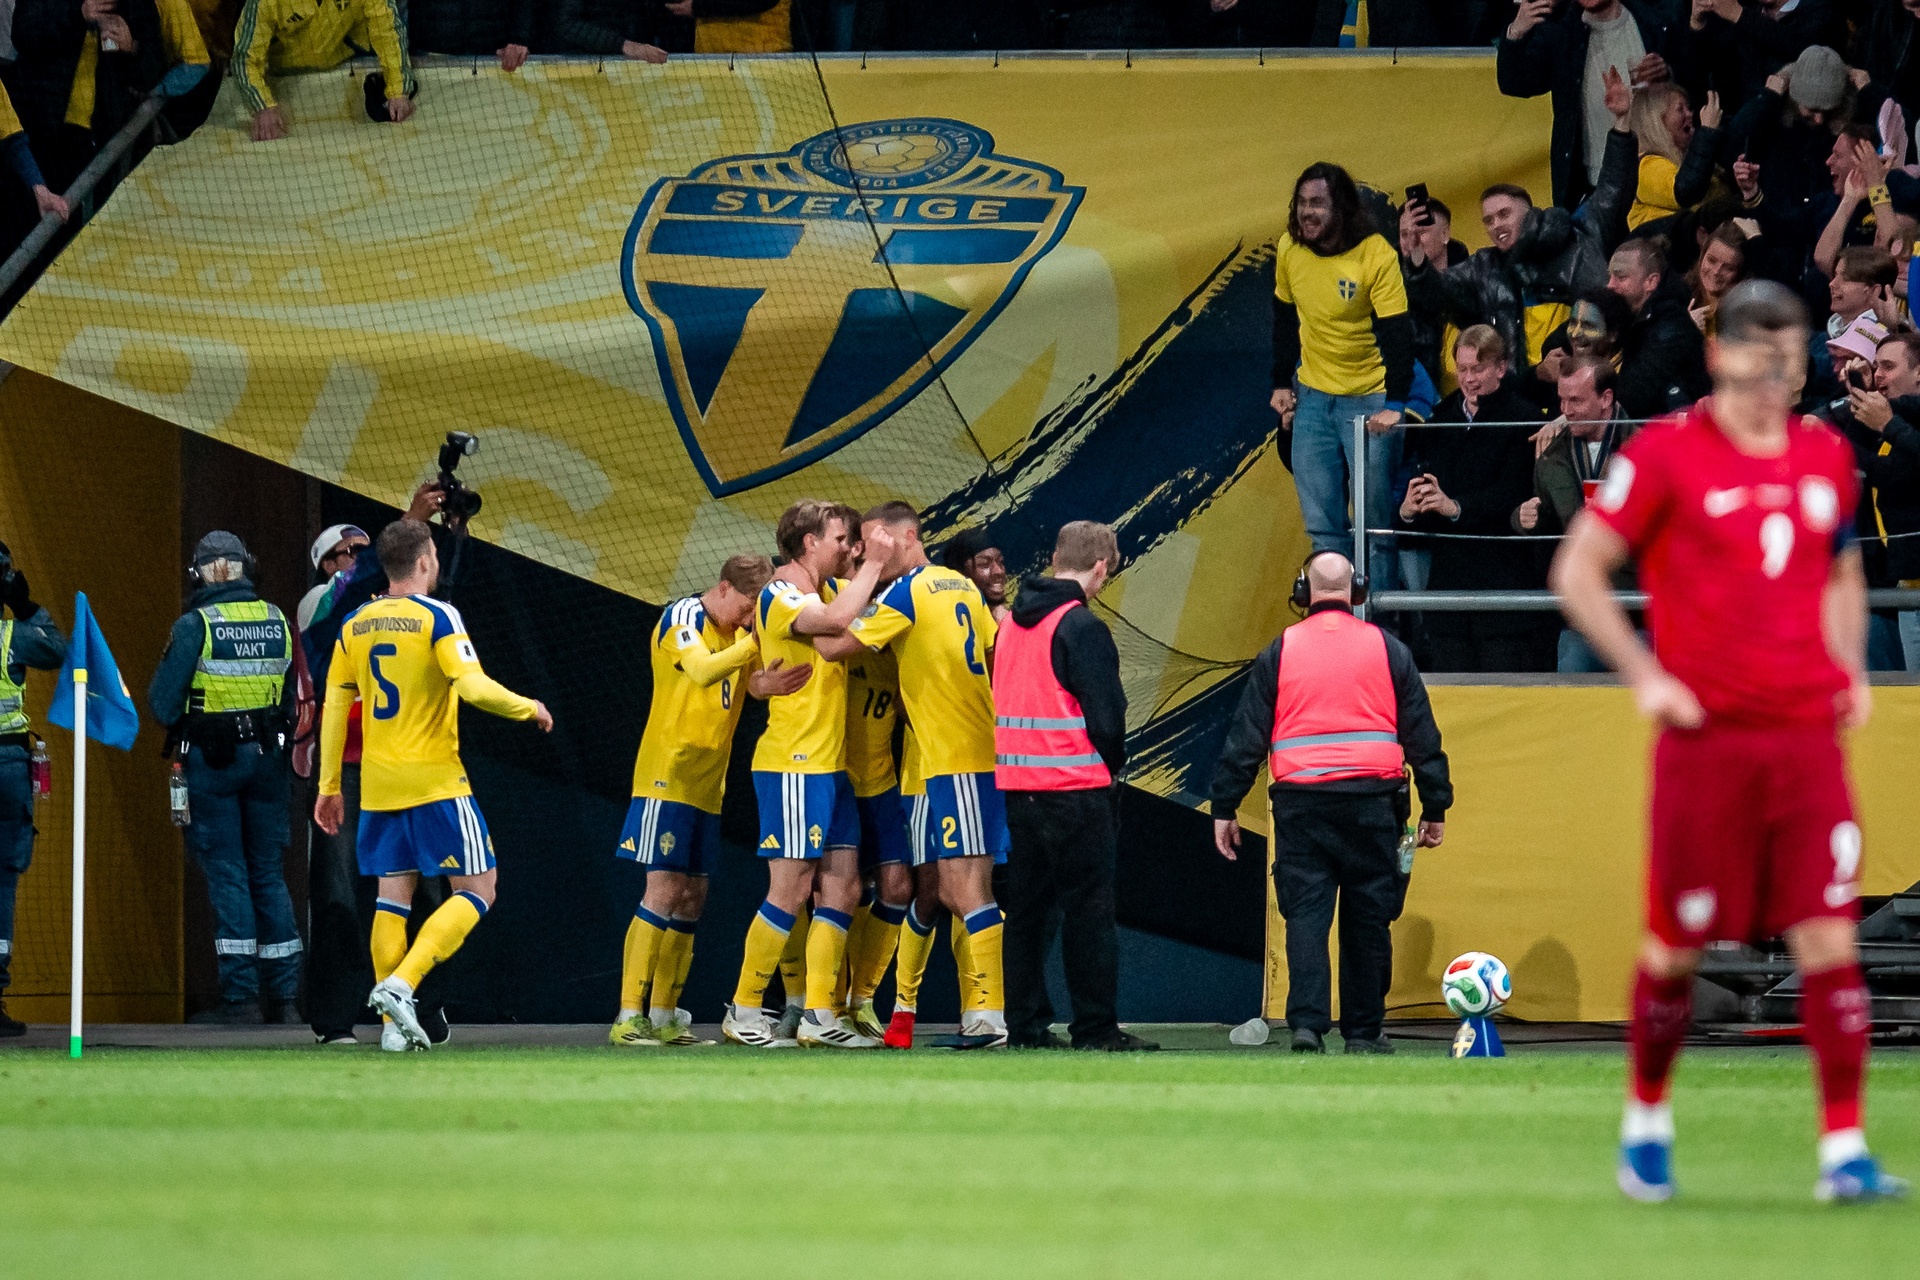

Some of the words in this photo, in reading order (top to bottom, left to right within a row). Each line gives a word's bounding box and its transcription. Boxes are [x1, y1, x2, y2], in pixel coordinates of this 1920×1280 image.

[711, 191, 1008, 221] SVERIGE
[1759, 512, 1796, 579] 9
[215, 624, 283, 641] ORDNINGS
[233, 641, 267, 657] VAKT
[955, 601, 985, 675] 2
[368, 643, 400, 721] 5
[721, 677, 731, 710] 8
[862, 687, 893, 719] 18
[941, 816, 958, 849] 2
